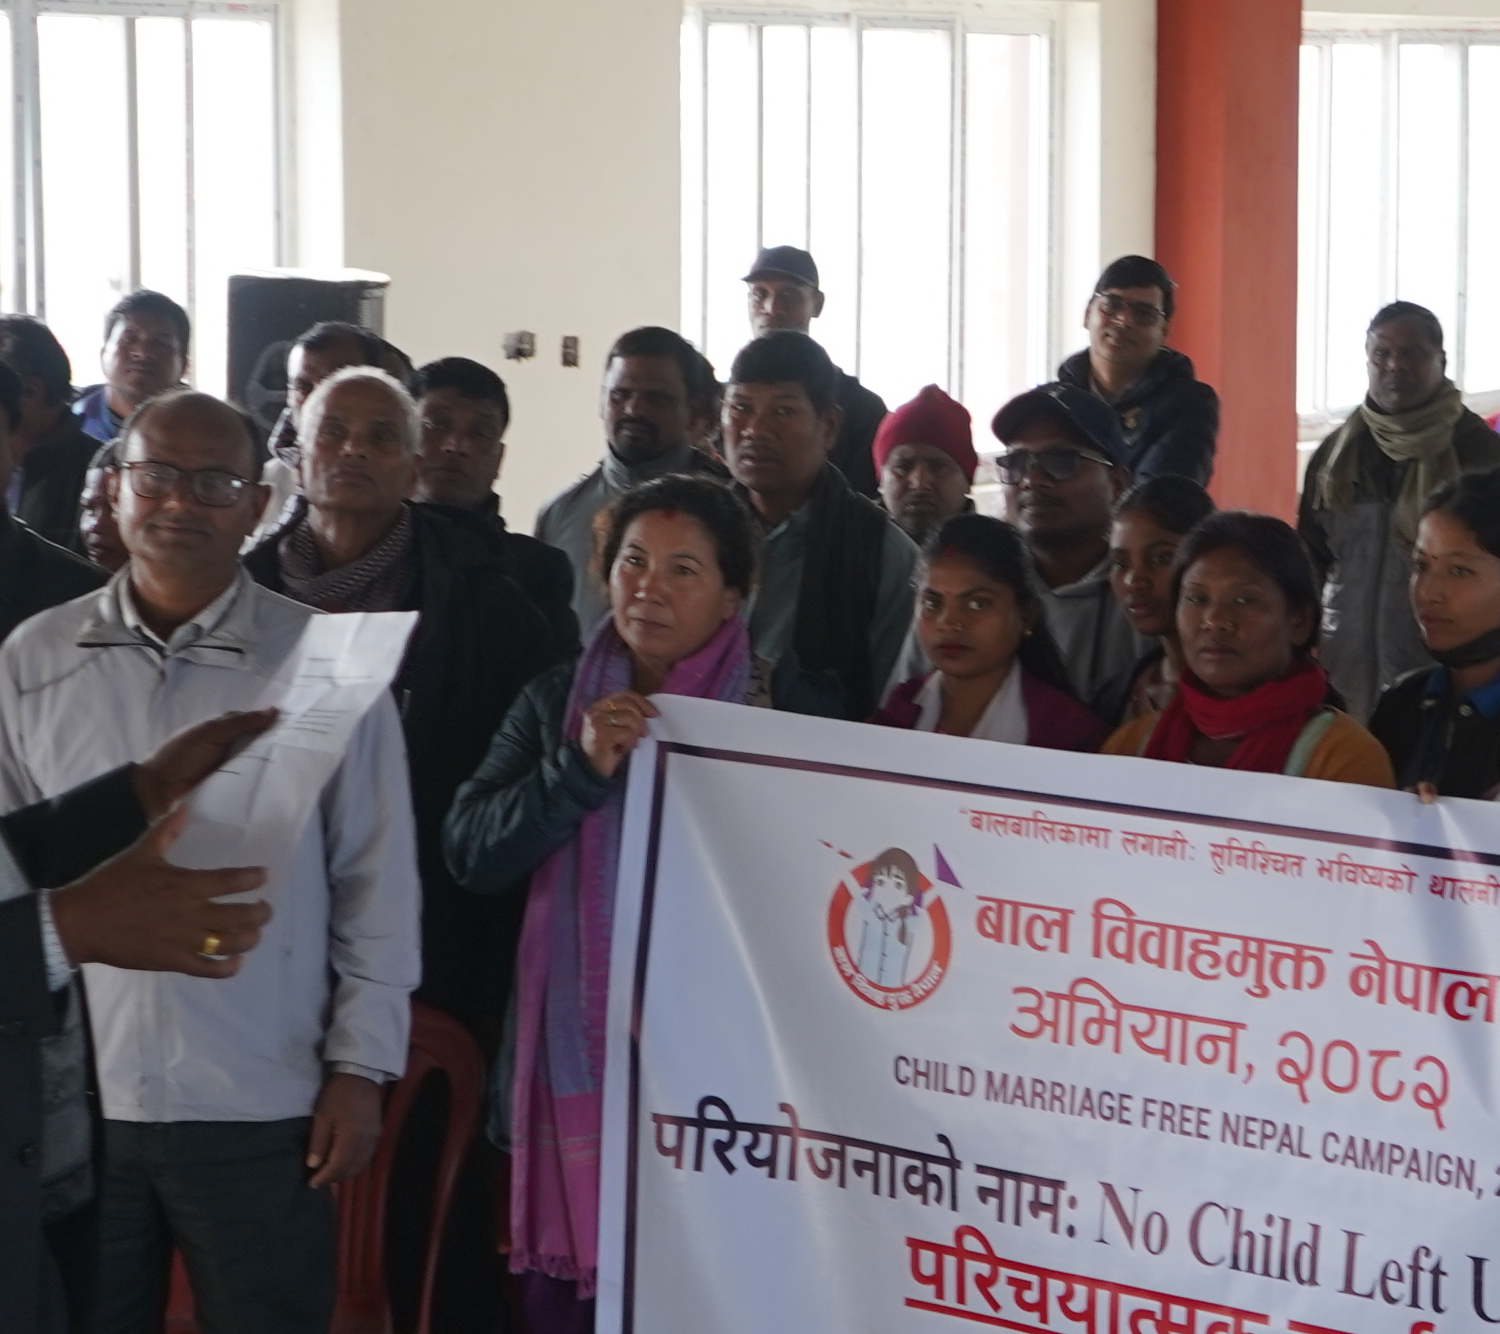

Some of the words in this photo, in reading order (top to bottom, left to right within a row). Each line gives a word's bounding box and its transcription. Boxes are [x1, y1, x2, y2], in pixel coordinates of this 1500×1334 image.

[975, 894, 1074, 956] बाल
[1092, 897, 1332, 999] विवाहमुक्त
[894, 1055, 975, 1098] CHILD
[985, 1072, 1130, 1127] MARRIAGE
[1141, 1098, 1211, 1141] FREE
[1221, 1111, 1310, 1160] NEPAL
[1321, 1133, 1484, 1199] CAMPAIGN,
[1009, 977, 1255, 1083] अभियान,
[1277, 1031, 1450, 1129] २०८२
[652, 1095, 961, 1213] परियोजनाको
[975, 1164, 1077, 1239] नाम:
[1095, 1181, 1169, 1257] No
[1189, 1200, 1320, 1287] Child
[1341, 1229, 1449, 1314] Left
